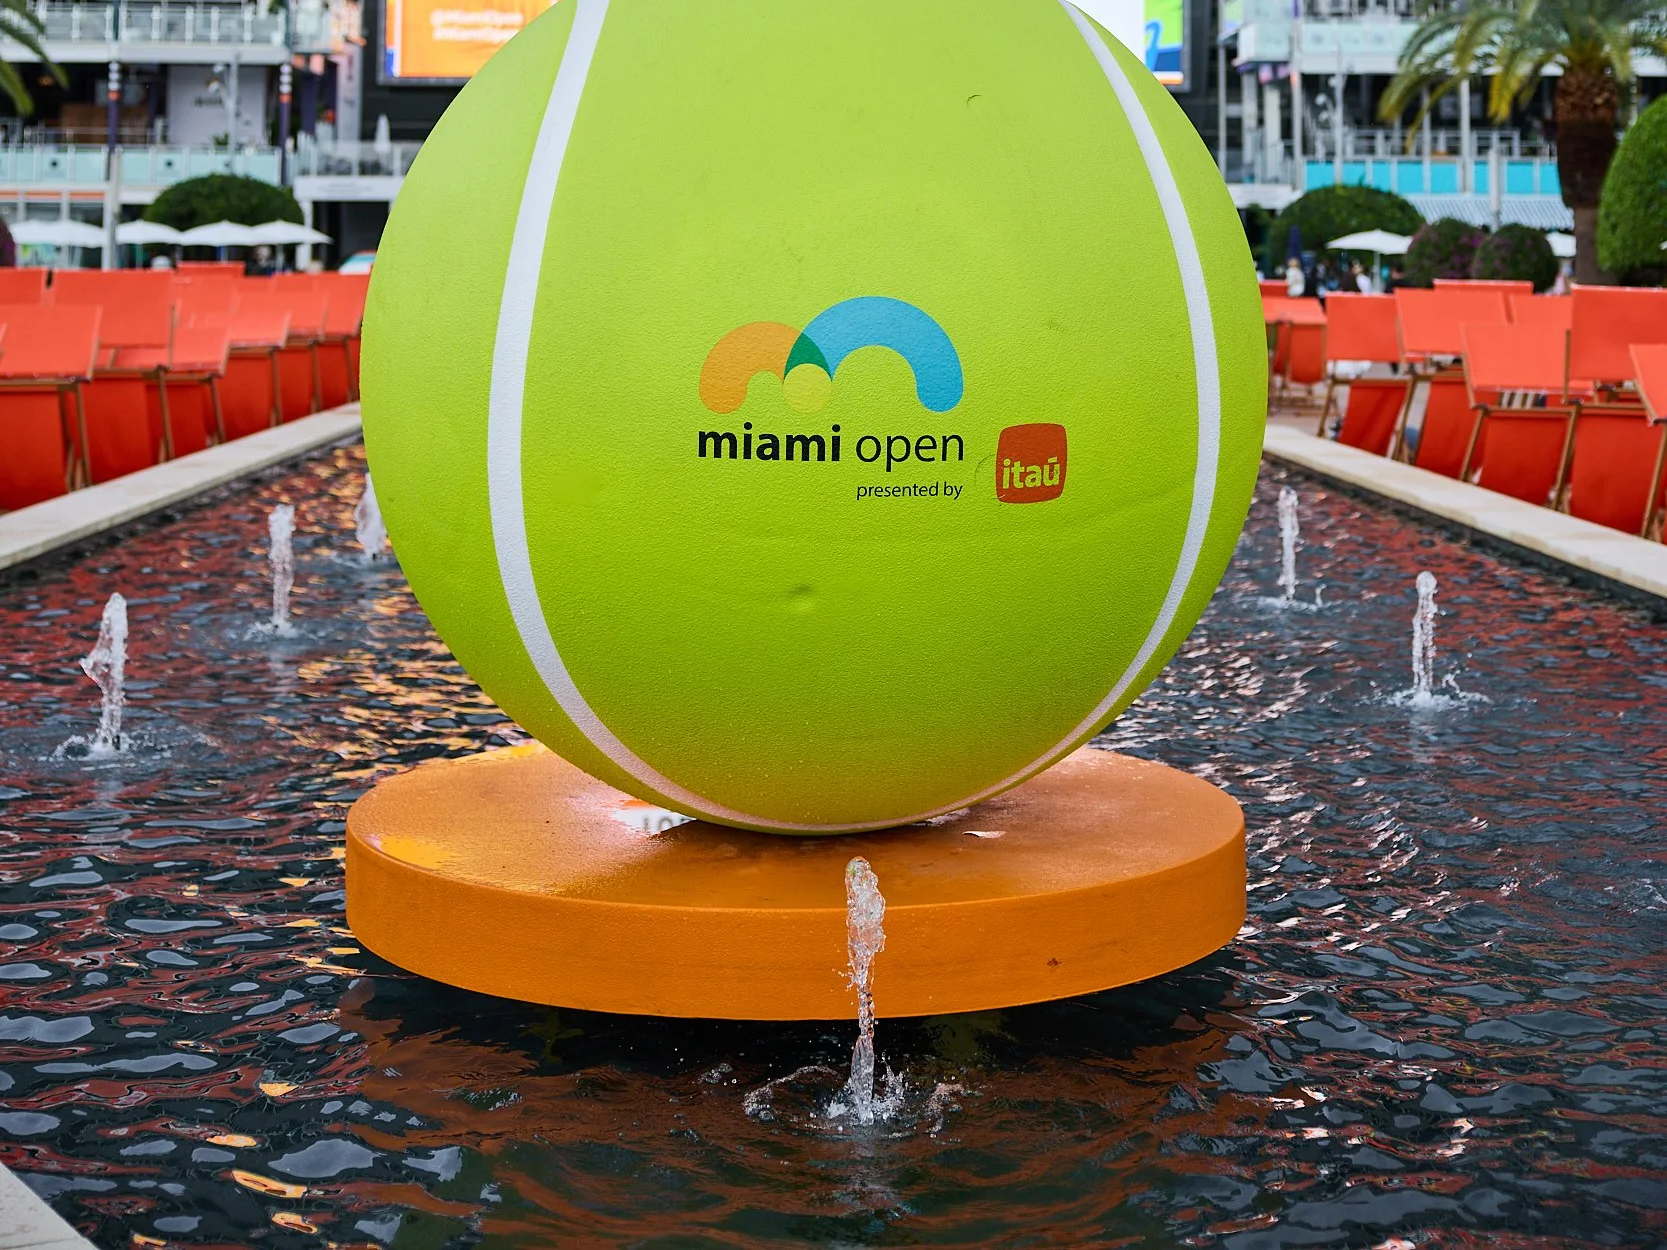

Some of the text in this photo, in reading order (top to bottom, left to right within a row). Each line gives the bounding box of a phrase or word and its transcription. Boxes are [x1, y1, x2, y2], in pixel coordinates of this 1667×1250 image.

[699, 422, 964, 472] miami open
[1002, 456, 1061, 490] itaú
[857, 482, 963, 500] presented by
